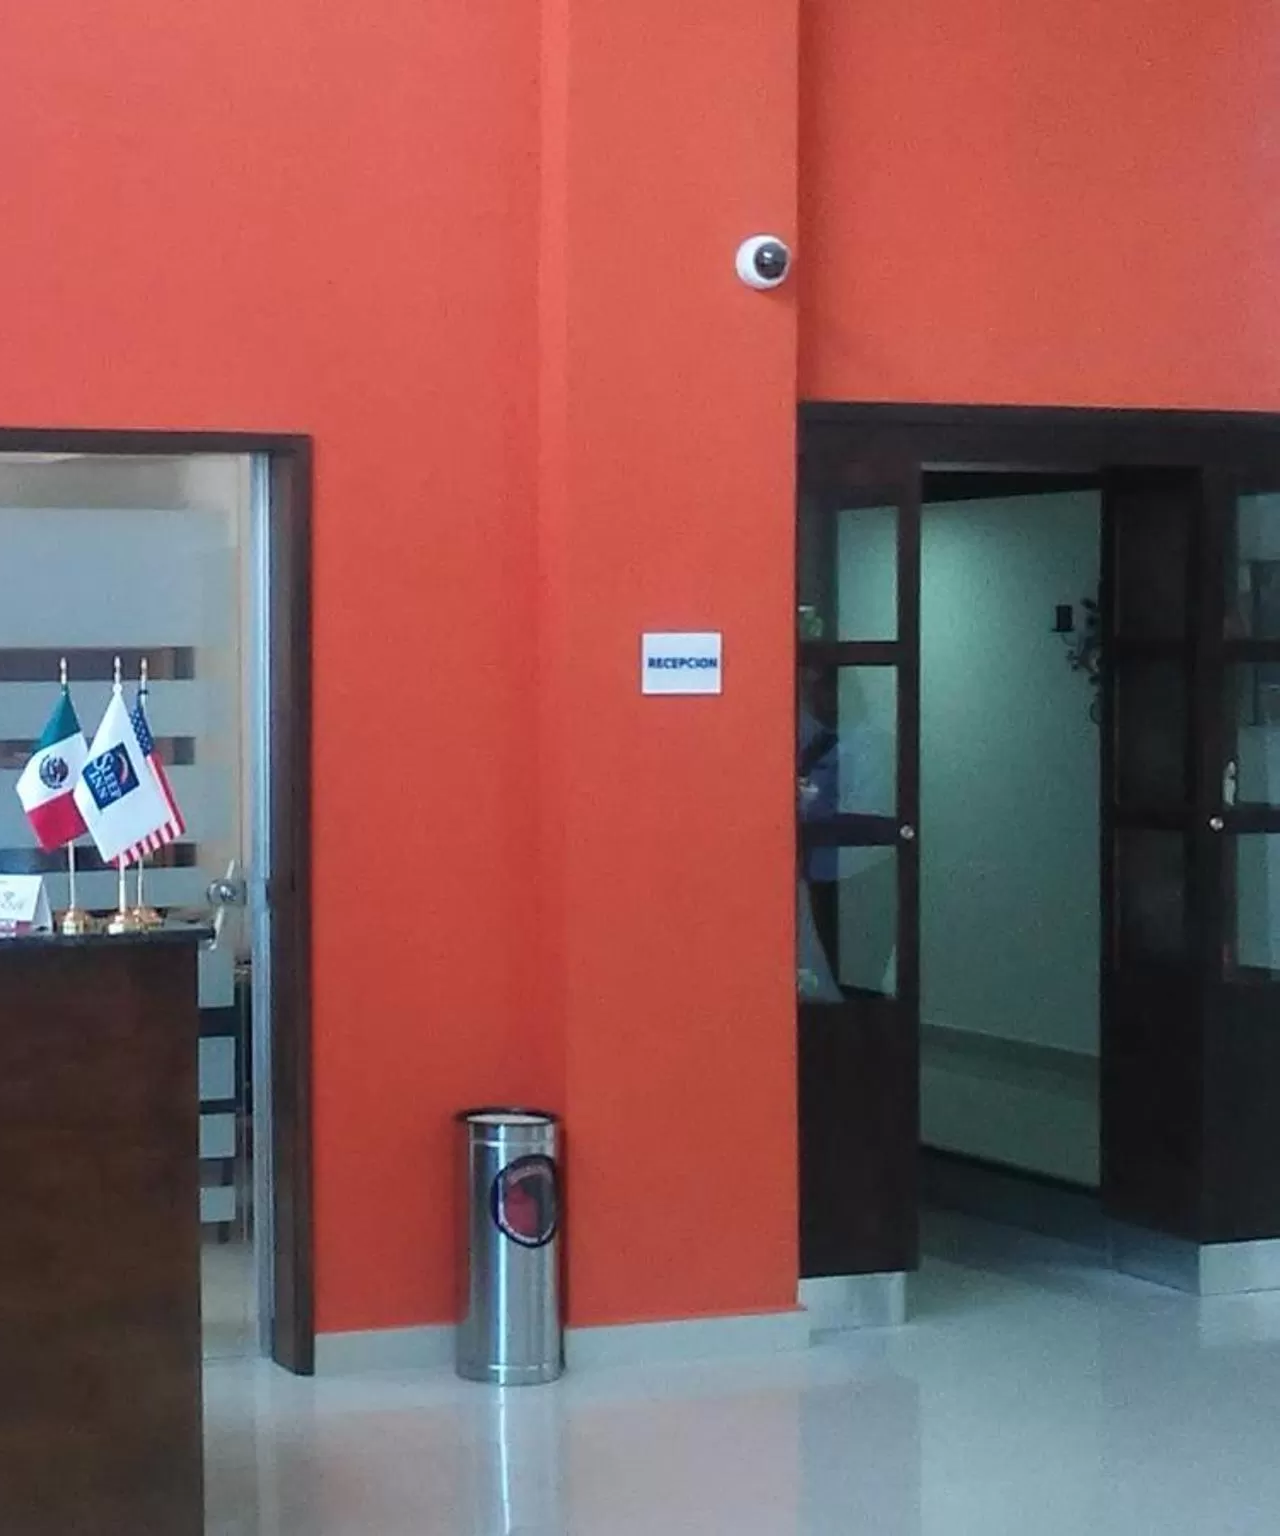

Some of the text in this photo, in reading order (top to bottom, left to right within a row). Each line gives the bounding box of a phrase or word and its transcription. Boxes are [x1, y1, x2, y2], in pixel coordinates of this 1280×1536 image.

[647, 656, 718, 669] RECEPCION
[88, 770, 109, 800] INN
[92, 752, 122, 799] SLEEP
